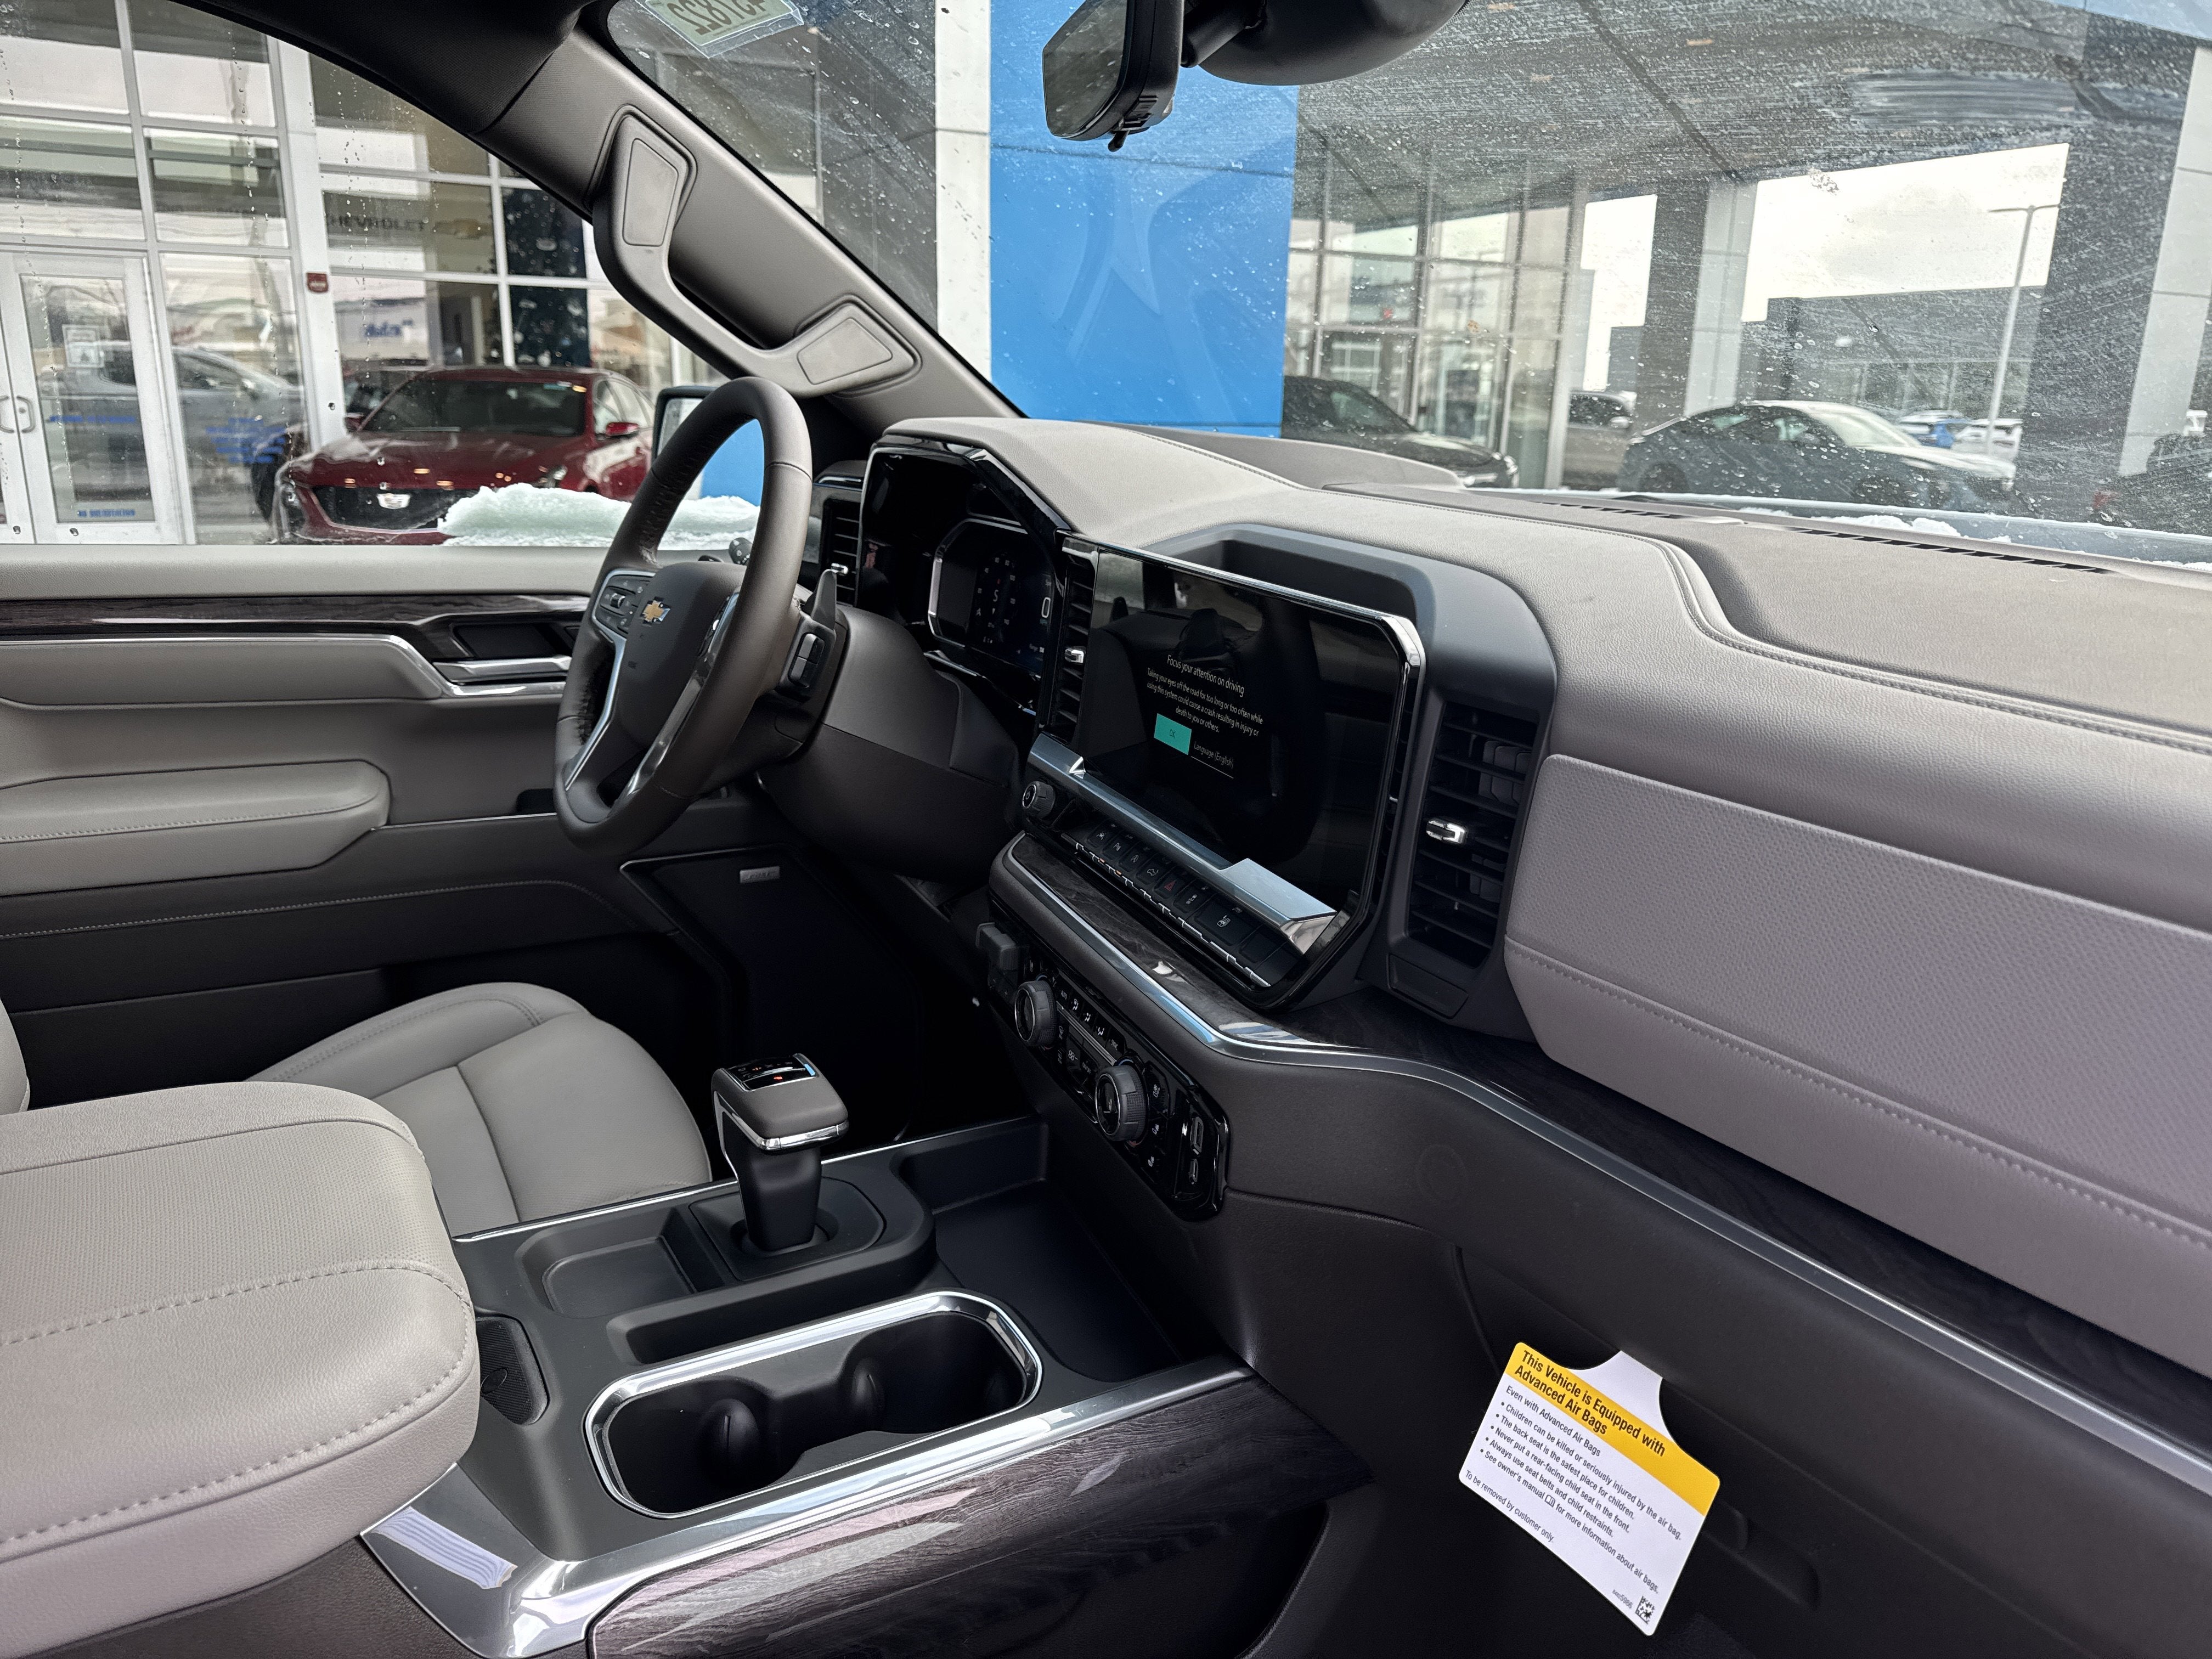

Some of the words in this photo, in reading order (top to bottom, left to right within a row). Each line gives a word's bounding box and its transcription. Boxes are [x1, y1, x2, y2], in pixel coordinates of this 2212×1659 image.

[1167, 654, 1181, 669] Focus
[1181, 663, 1193, 673] your
[1193, 667, 1217, 683] attention
[1217, 678, 1224, 686] on
[1225, 678, 1244, 697] driving
[1190, 688, 1200, 697] road
[1214, 696, 1224, 710] long
[1238, 708, 1250, 719] often
[1251, 713, 1263, 724] while
[1194, 741, 1214, 759] Language
[1214, 751, 1234, 769] (English)
[1205, 720, 1219, 732] others.
[1235, 719, 1240, 728] in
[1506, 1385, 1523, 1402] Even
[1524, 1398, 1539, 1413] with
[1539, 1408, 1573, 1436] Advanced
[1572, 1432, 1584, 1443] Air
[1583, 1438, 1601, 1457] Bags
[1514, 1365, 1566, 1404] Advanced
[1565, 1398, 1582, 1415] Air
[1581, 1408, 1607, 1435] Bags
[1522, 1350, 1543, 1372] This
[1545, 1365, 1581, 1397] Vehicle
[1582, 1390, 1592, 1405] is
[1593, 1398, 1641, 1439] Equipped
[1642, 1434, 1665, 1457] with
[1466, 1470, 1472, 1480] To
[1472, 1476, 1481, 1486] be
[1481, 1483, 1507, 1505] removed
[1506, 1500, 1515, 1511] by
[1514, 1508, 1542, 1531] customer
[1489, 1440, 1512, 1459] Always
[1513, 1456, 1525, 1468] use
[1525, 1465, 1539, 1479] seat
[1539, 1474, 1555, 1491] belts
[1555, 1488, 1568, 1500] and
[1567, 1497, 1584, 1513] child
[1583, 1509, 1613, 1538] restraints.
[1495, 1427, 1514, 1444] Never
[1513, 1442, 1525, 1453] put
[1531, 1454, 1565, 1483] rear-facing
[1565, 1479, 1581, 1494] child
[1580, 1491, 1595, 1505] seat
[1595, 1500, 1602, 1510] in
[1602, 1506, 1613, 1519] the
[1613, 1515, 1629, 1533] front.
[1501, 1415, 1513, 1428] The
[1513, 1424, 1529, 1440] back
[1528, 1437, 1543, 1450] seat
[1543, 1445, 1549, 1454] is
[1550, 1451, 1560, 1463] the
[1561, 1460, 1581, 1477] safest
[1579, 1474, 1598, 1491] place
[1598, 1486, 1608, 1498] for
[1608, 1496, 1634, 1520] children.
[1506, 1404, 1533, 1427] Children
[1533, 1424, 1546, 1436] can
[1547, 1432, 1555, 1443] be
[1556, 1438, 1575, 1457] killed
[1575, 1454, 1583, 1462] or
[1583, 1460, 1612, 1486] seriously
[1612, 1480, 1637, 1503] injured
[1637, 1498, 1646, 1511] by
[1646, 1506, 1657, 1520] the
[1657, 1517, 1668, 1527] air
[1668, 1523, 1681, 1541] bag.
[1485, 1451, 1497, 1464] See
[1497, 1461, 1522, 1482] owner's
[1522, 1479, 1545, 1499] manual
[1555, 1503, 1566, 1514] for
[1565, 1512, 1581, 1528] more
[1582, 1523, 1616, 1556] information
[1616, 1553, 1635, 1572] about
[1634, 1568, 1644, 1578] air
[1643, 1574, 1658, 1594] bags.
